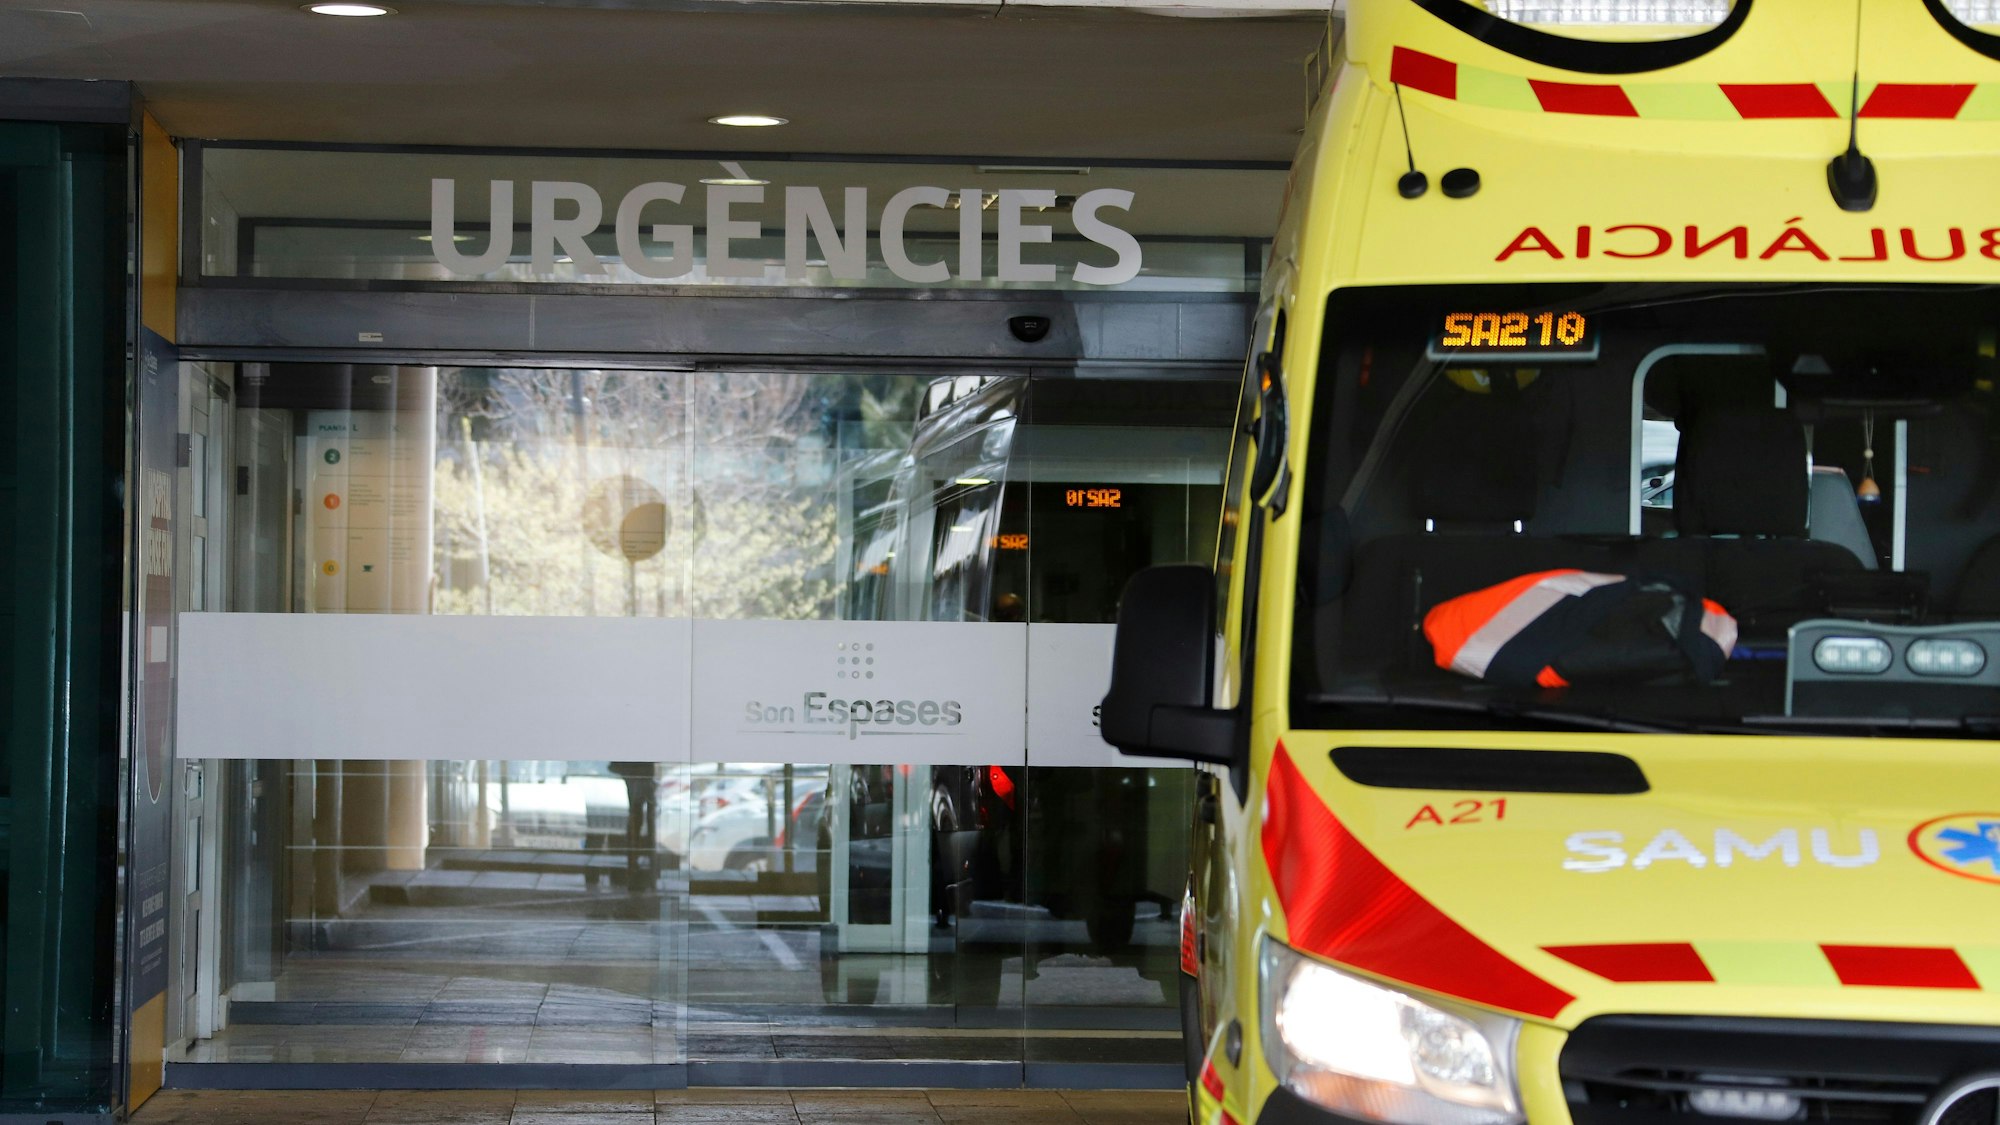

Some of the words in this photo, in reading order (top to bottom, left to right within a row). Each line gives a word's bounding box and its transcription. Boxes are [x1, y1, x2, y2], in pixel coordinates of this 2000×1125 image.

[430, 162, 1143, 286] URGÈNCIES
[1442, 311, 1586, 347] SA210
[745, 700, 795, 724] Son
[804, 691, 962, 740] Espases
[1405, 798, 1507, 830] A21
[1561, 827, 1881, 874] SAMU
